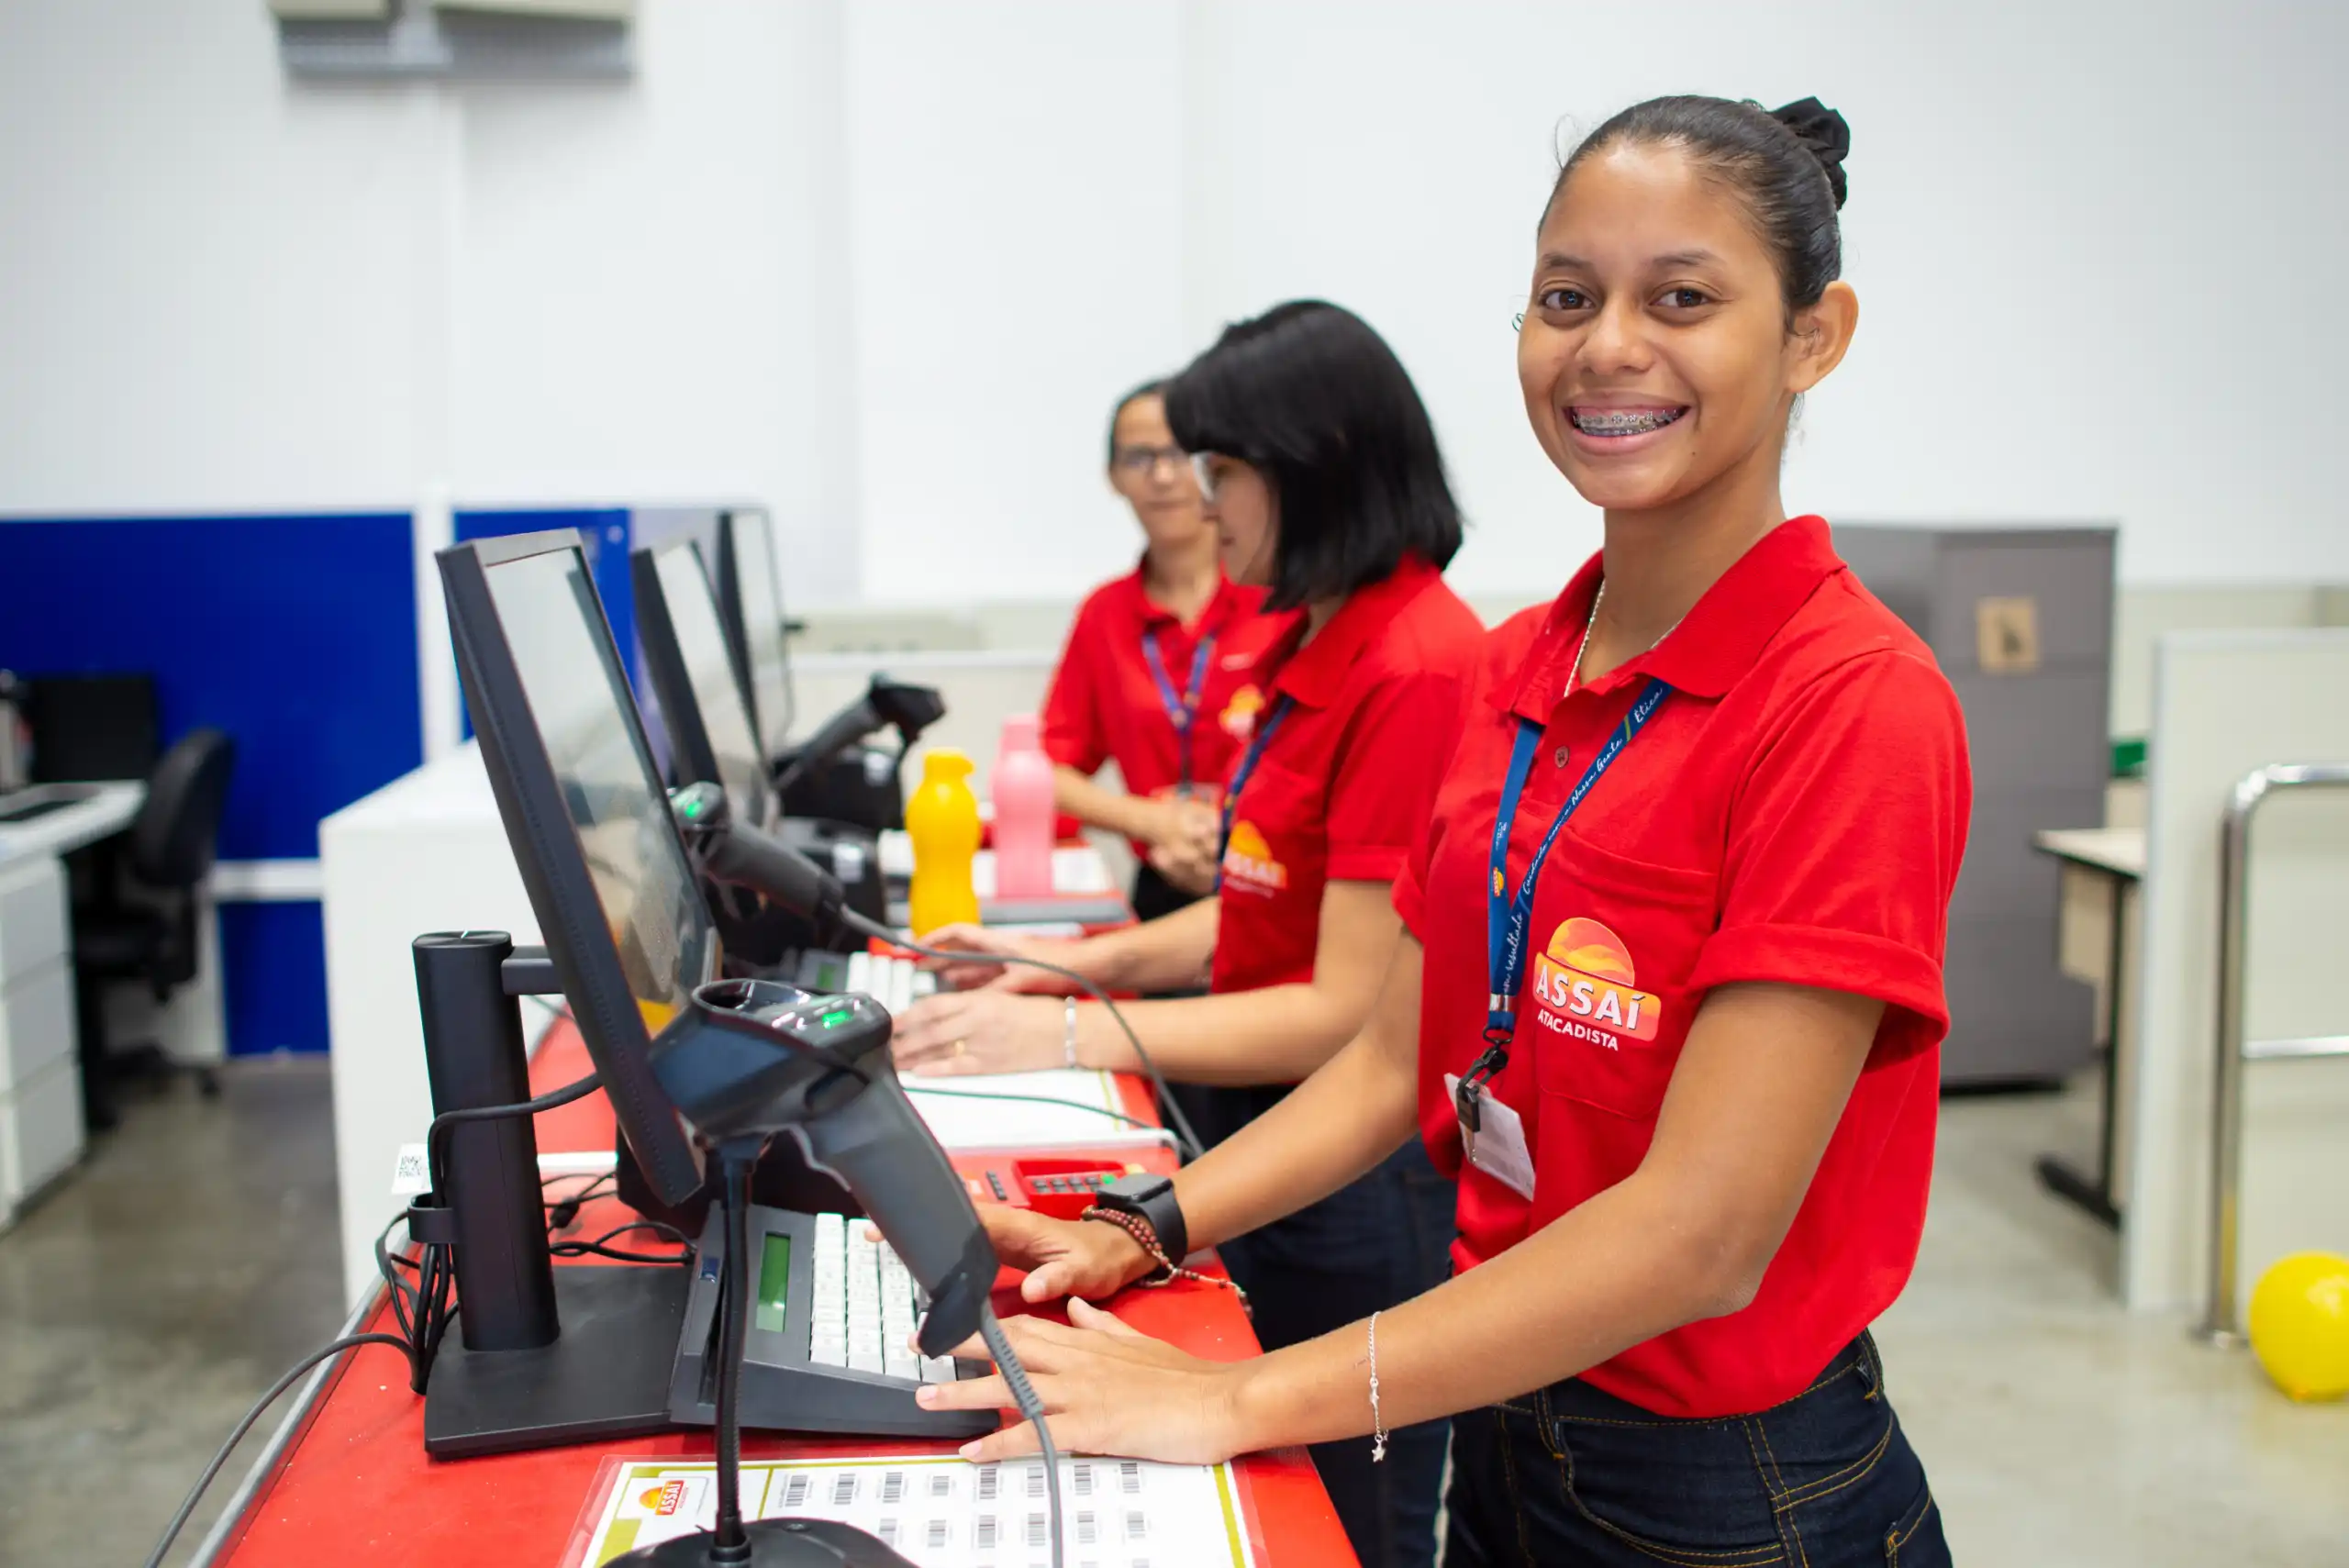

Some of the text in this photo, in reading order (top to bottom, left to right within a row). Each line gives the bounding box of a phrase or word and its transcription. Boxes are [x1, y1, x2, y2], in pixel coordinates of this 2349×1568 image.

[1572, 771, 1597, 806] Nossa
[1597, 738, 1623, 773] Gente
[1505, 912, 1523, 971] resultado
[1535, 964, 1646, 1030] ASSAÍ
[1537, 1008, 1619, 1051] ATACADISTA
